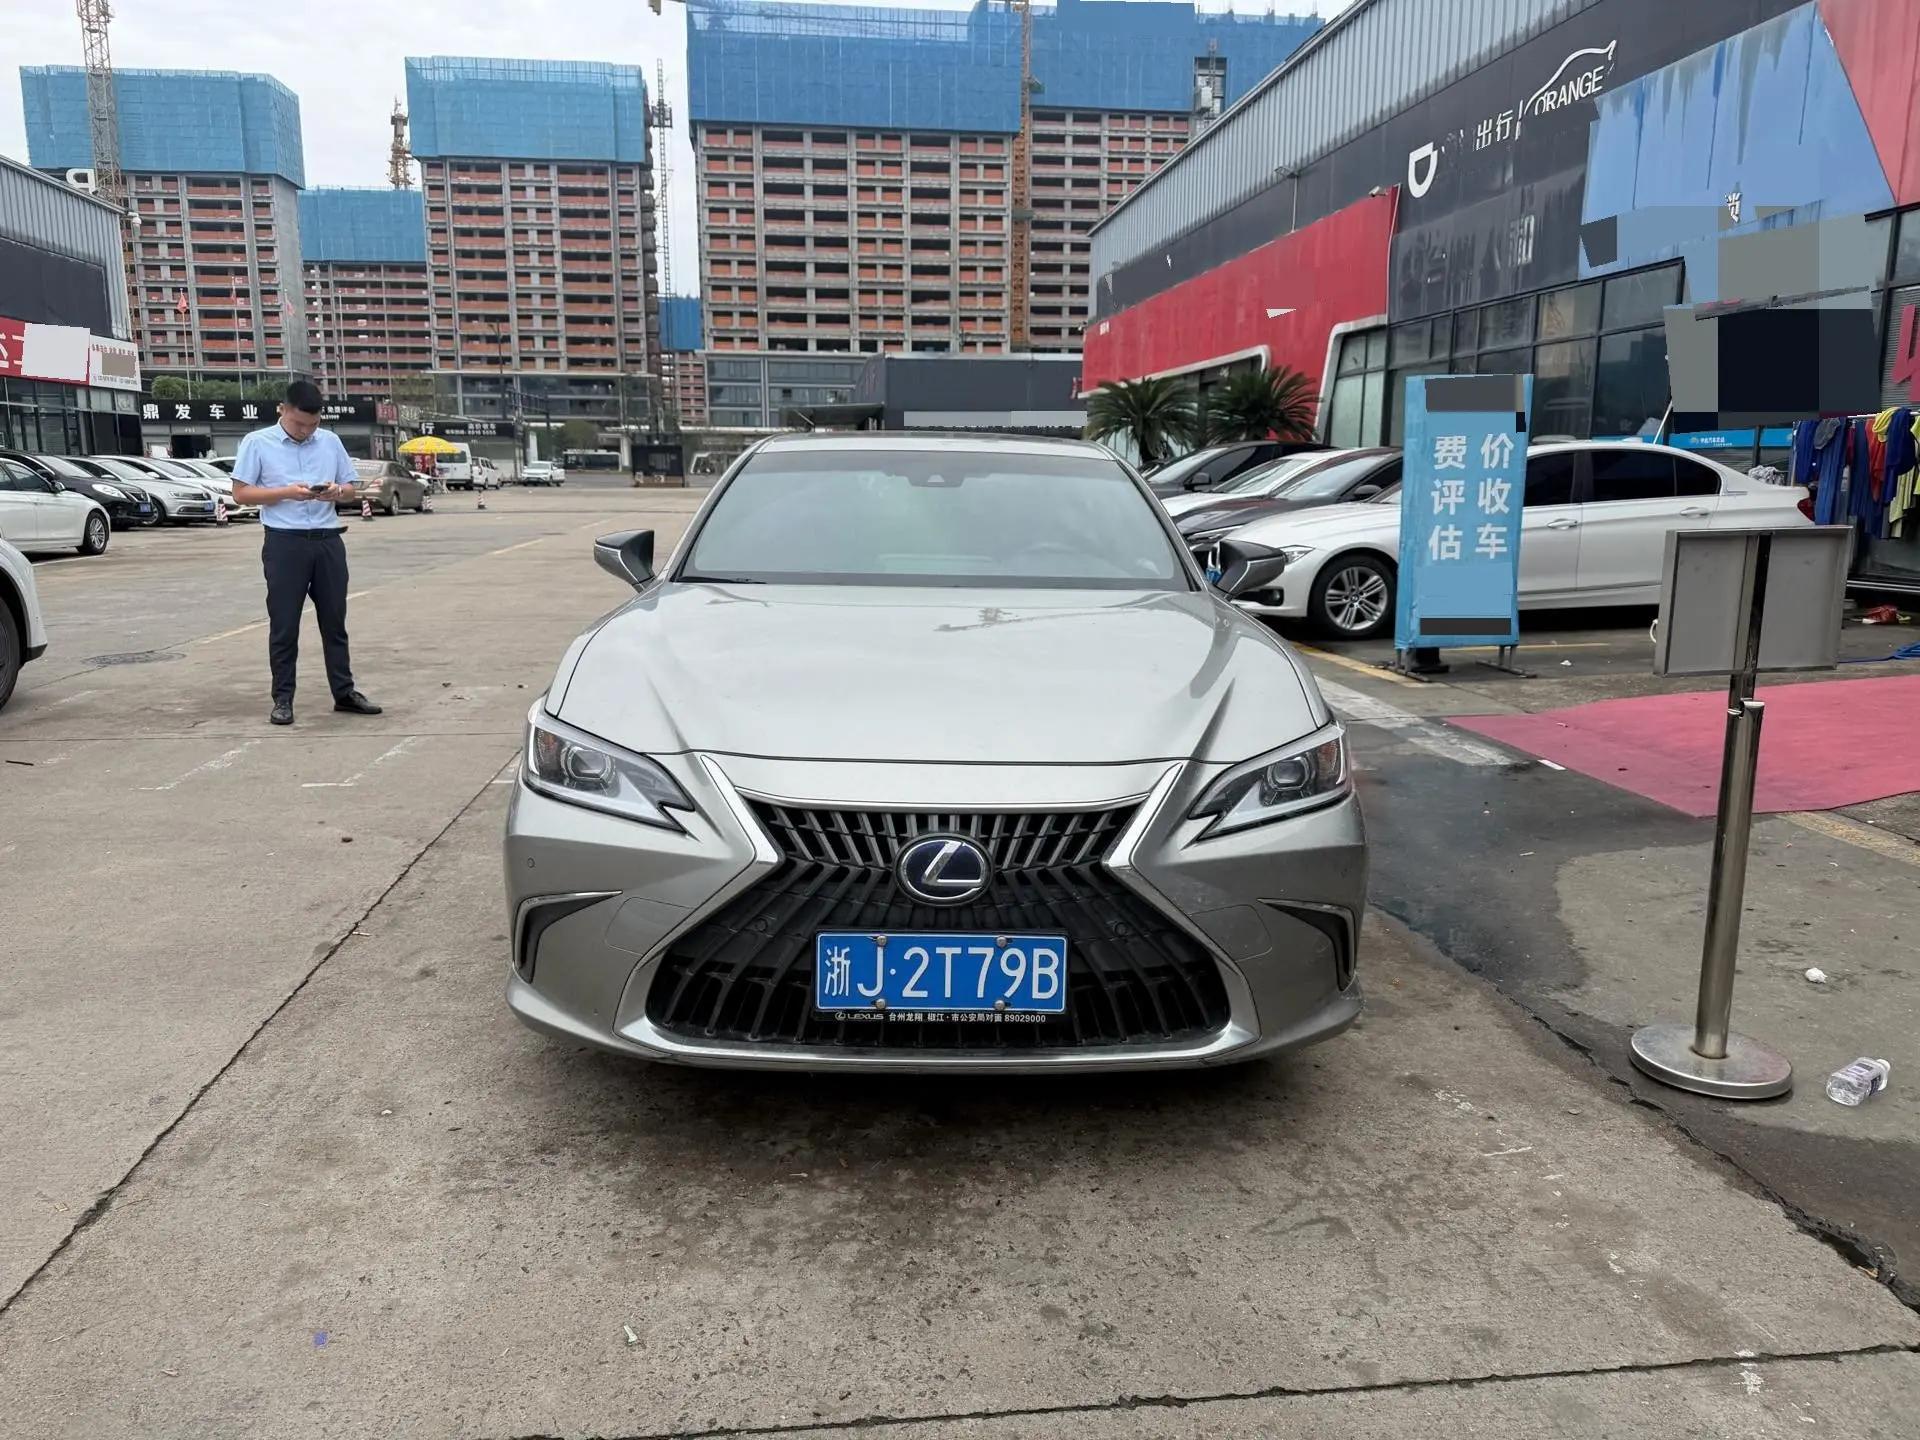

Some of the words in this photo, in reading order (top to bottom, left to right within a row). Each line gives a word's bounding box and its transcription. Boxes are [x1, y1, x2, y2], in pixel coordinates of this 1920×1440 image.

[1534, 65, 1605, 116] ORANGE
[142, 403, 259, 420] 鼎发车业
[824, 946, 1060, 1000] 浙J·2T79B
[1004, 1014, 1046, 1023] 89029000
